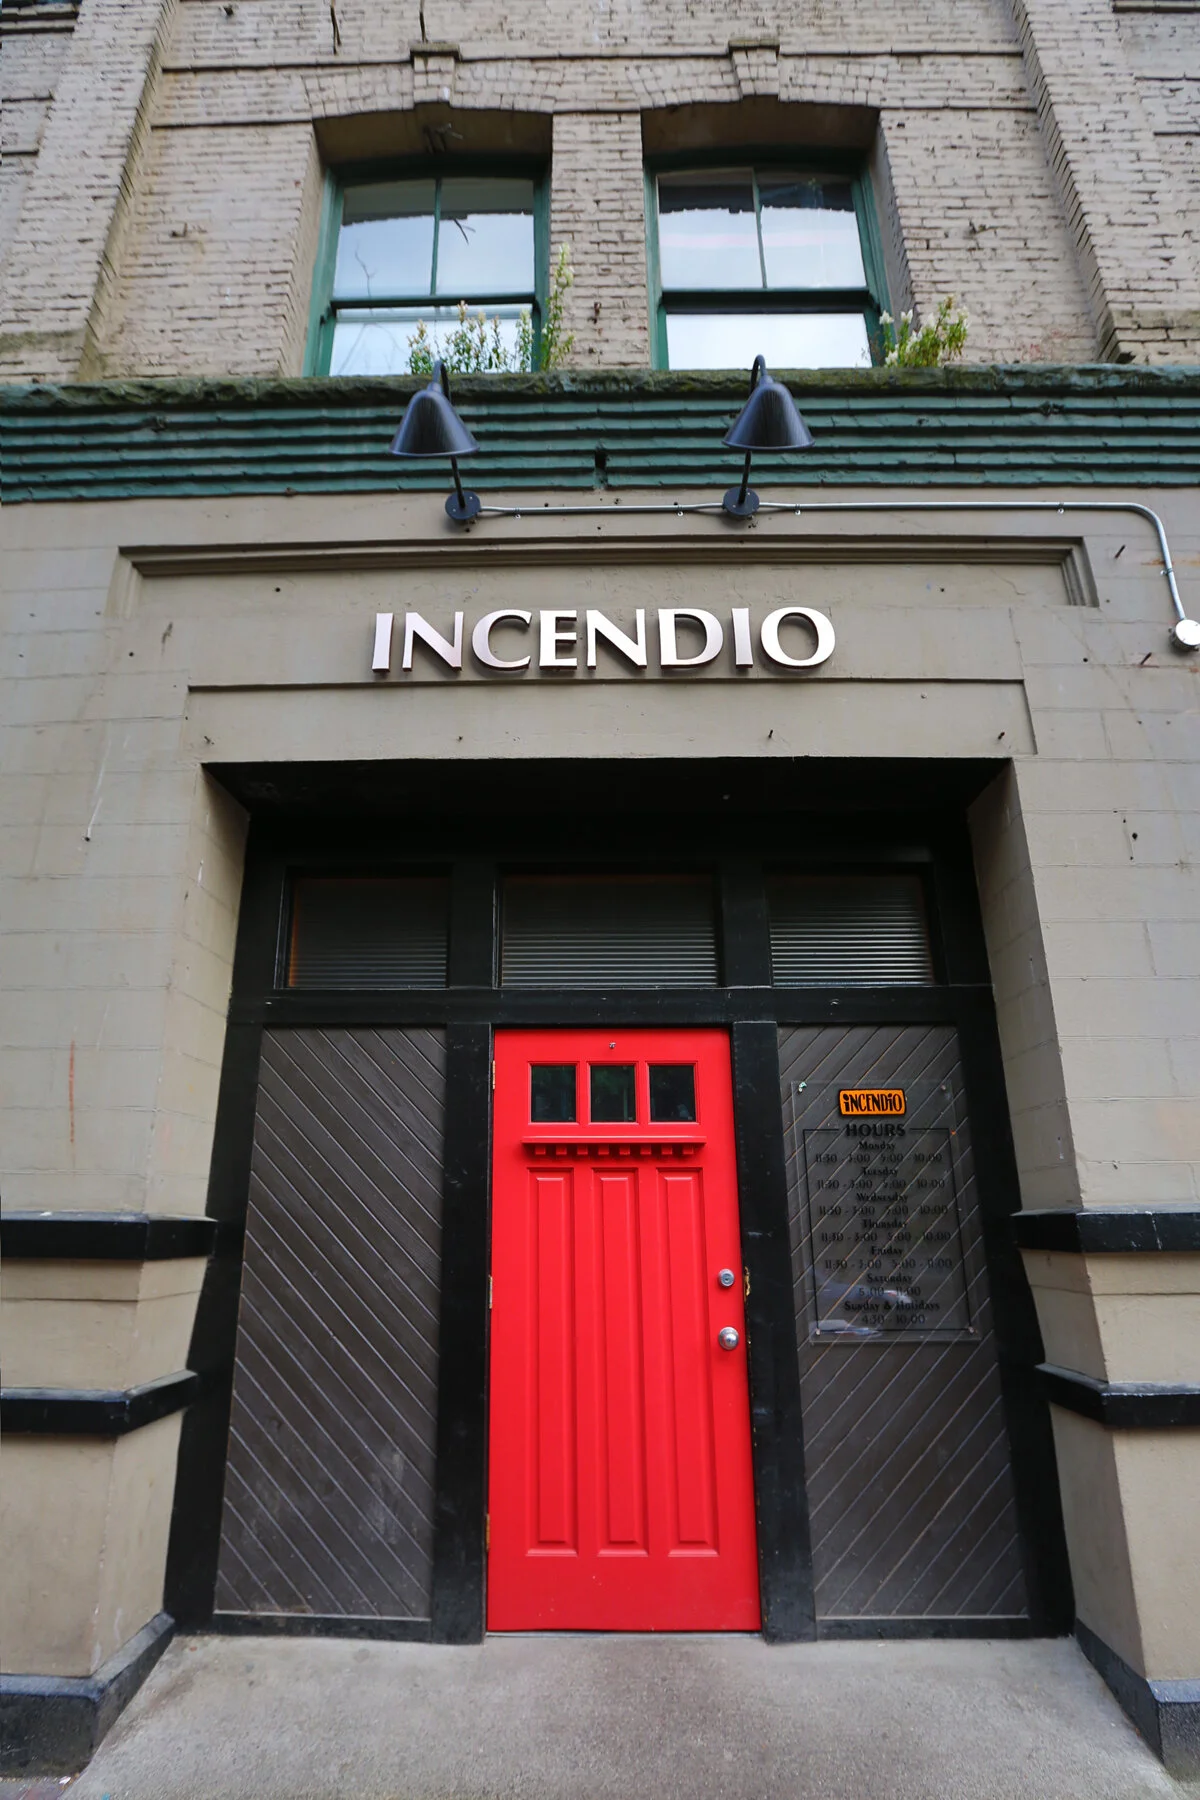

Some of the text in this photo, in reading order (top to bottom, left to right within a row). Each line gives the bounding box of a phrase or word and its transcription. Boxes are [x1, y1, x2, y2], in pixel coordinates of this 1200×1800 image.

[371, 607, 836, 672] INCENDIO
[845, 1123, 906, 1137] HOURS
[859, 1141, 896, 1150] Monday
[861, 1166, 898, 1176] Tuesday
[856, 1193, 908, 1203] Wednesday
[862, 1219, 907, 1229] Thursday
[871, 1246, 903, 1255] Friday
[824, 1259, 848, 1269] 11:30
[866, 1272, 913, 1283] Saturday
[844, 1300, 940, 1311] Sunday & Holidays
